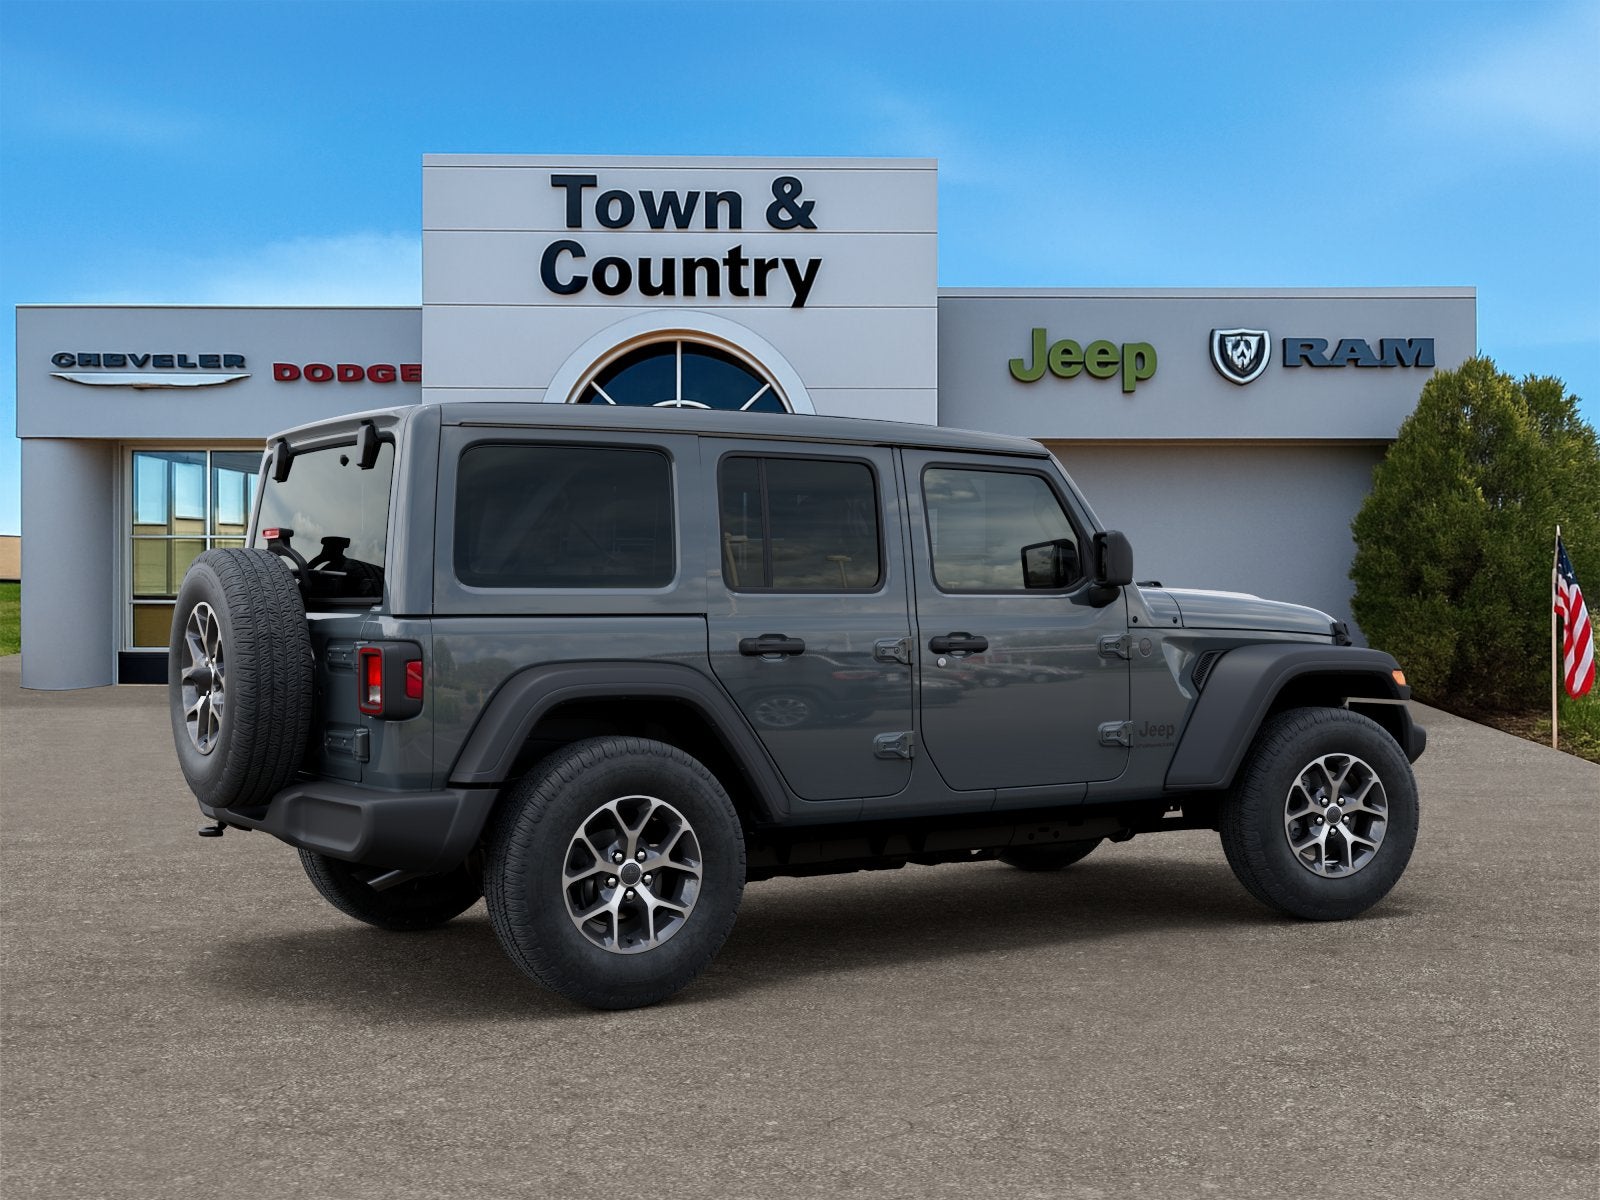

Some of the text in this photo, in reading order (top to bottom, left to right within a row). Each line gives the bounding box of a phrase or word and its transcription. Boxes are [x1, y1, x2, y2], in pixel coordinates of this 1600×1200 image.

[550, 174, 818, 229] Town &
[540, 239, 822, 308] Country
[273, 362, 422, 383] DODGE
[1009, 327, 1157, 392] Jeep
[1282, 337, 1435, 368] RAM
[1138, 720, 1175, 739] Jeep
